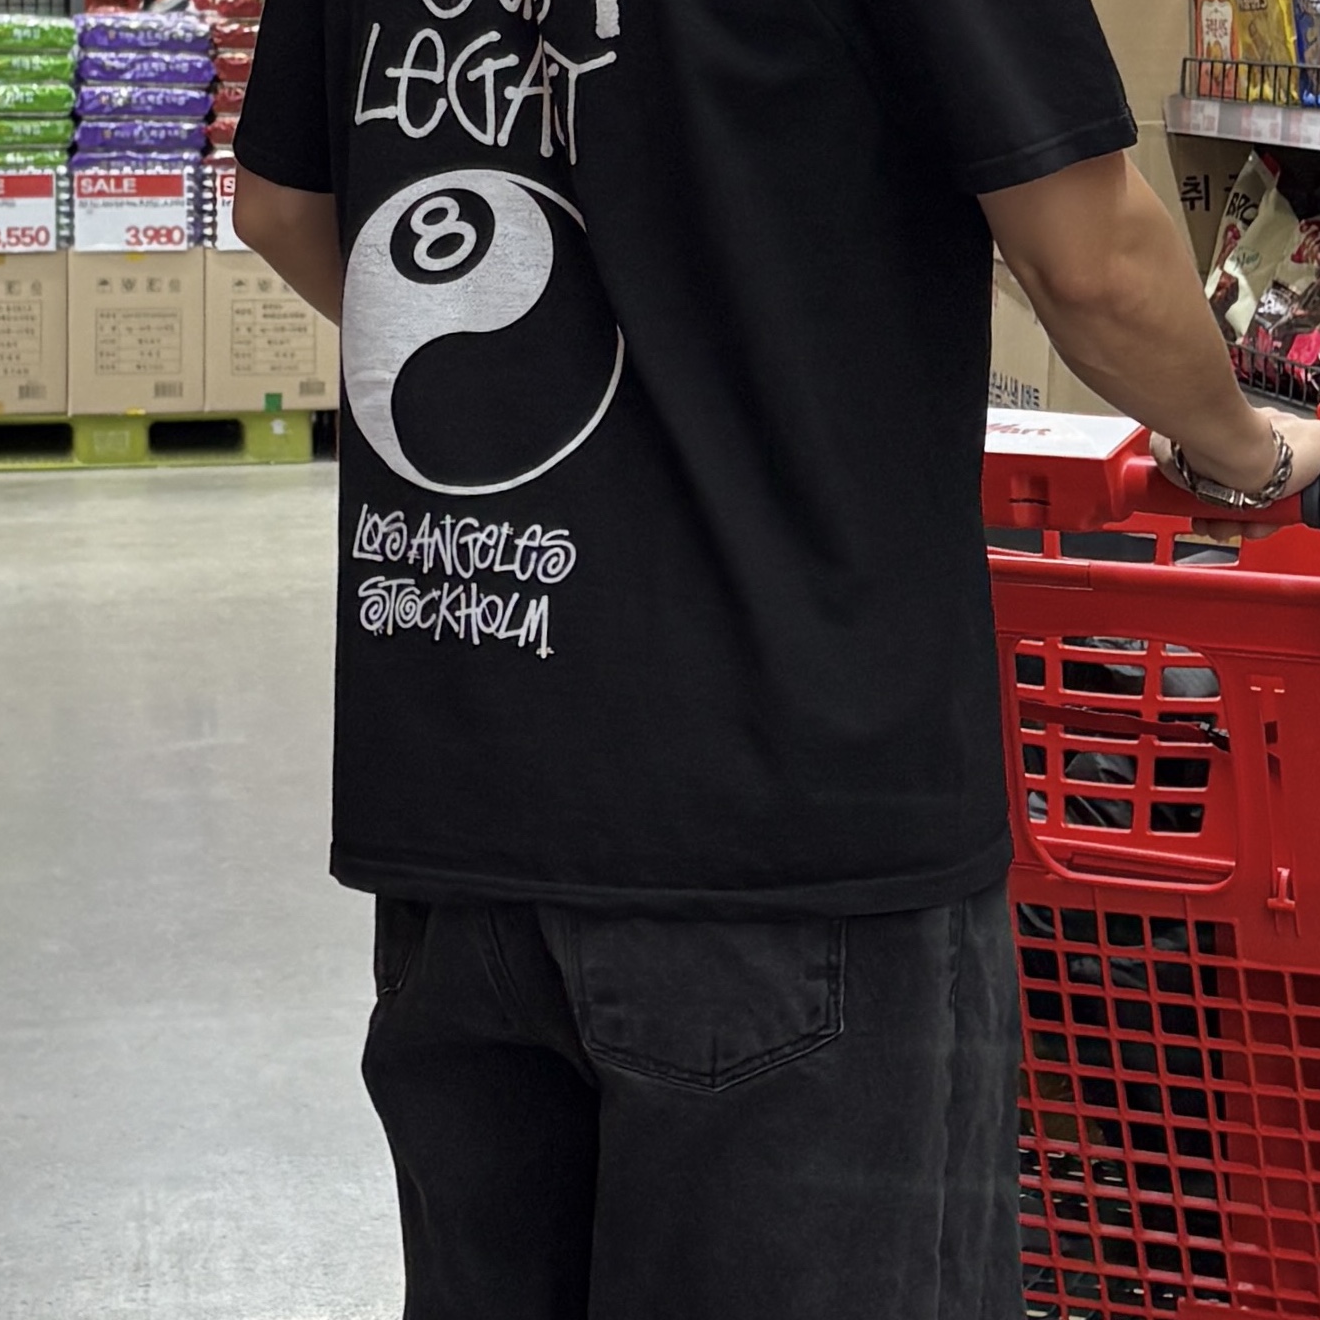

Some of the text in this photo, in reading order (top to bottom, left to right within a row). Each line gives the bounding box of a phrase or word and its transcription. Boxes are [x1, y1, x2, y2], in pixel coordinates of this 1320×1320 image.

[81, 178, 137, 195] SALE
[125, 226, 184, 247] 3,980
[408, 196, 478, 275] 8
[353, 503, 408, 562] LOS
[357, 576, 555, 660] STOCKHOLM
